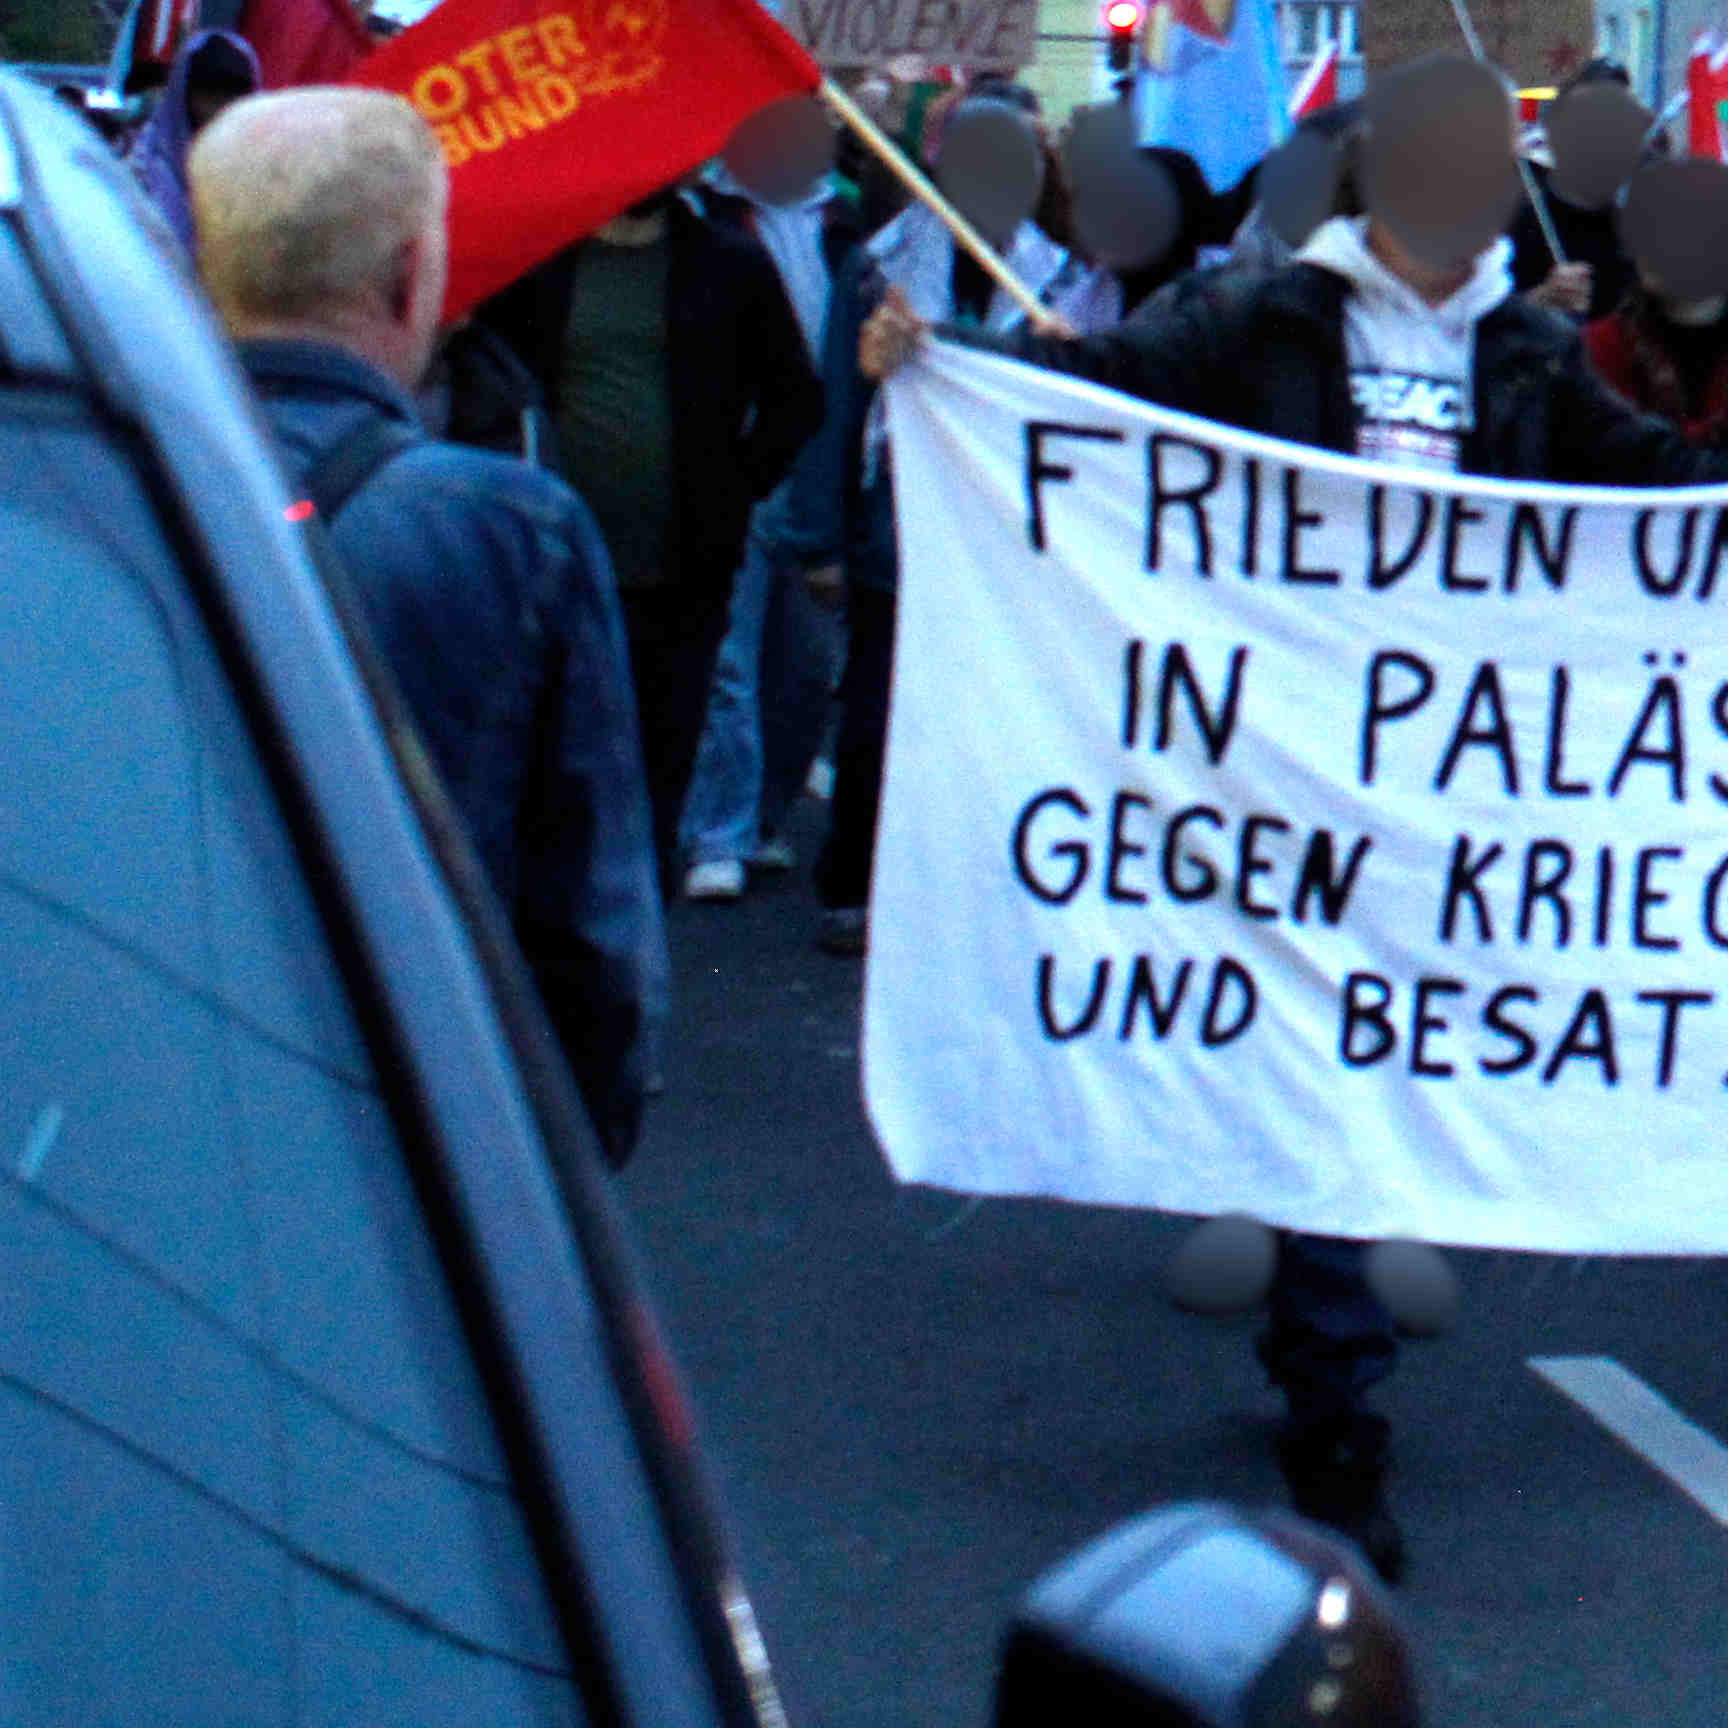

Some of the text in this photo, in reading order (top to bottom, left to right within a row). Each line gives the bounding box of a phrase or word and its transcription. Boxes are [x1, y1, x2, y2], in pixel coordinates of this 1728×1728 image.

[412, 13, 587, 120] OTER
[1023, 419, 1580, 594] FRIEDEN
[1122, 638, 1249, 767] IN
[1011, 787, 1375, 927] GEGEN
[1036, 953, 1260, 1049] UND
